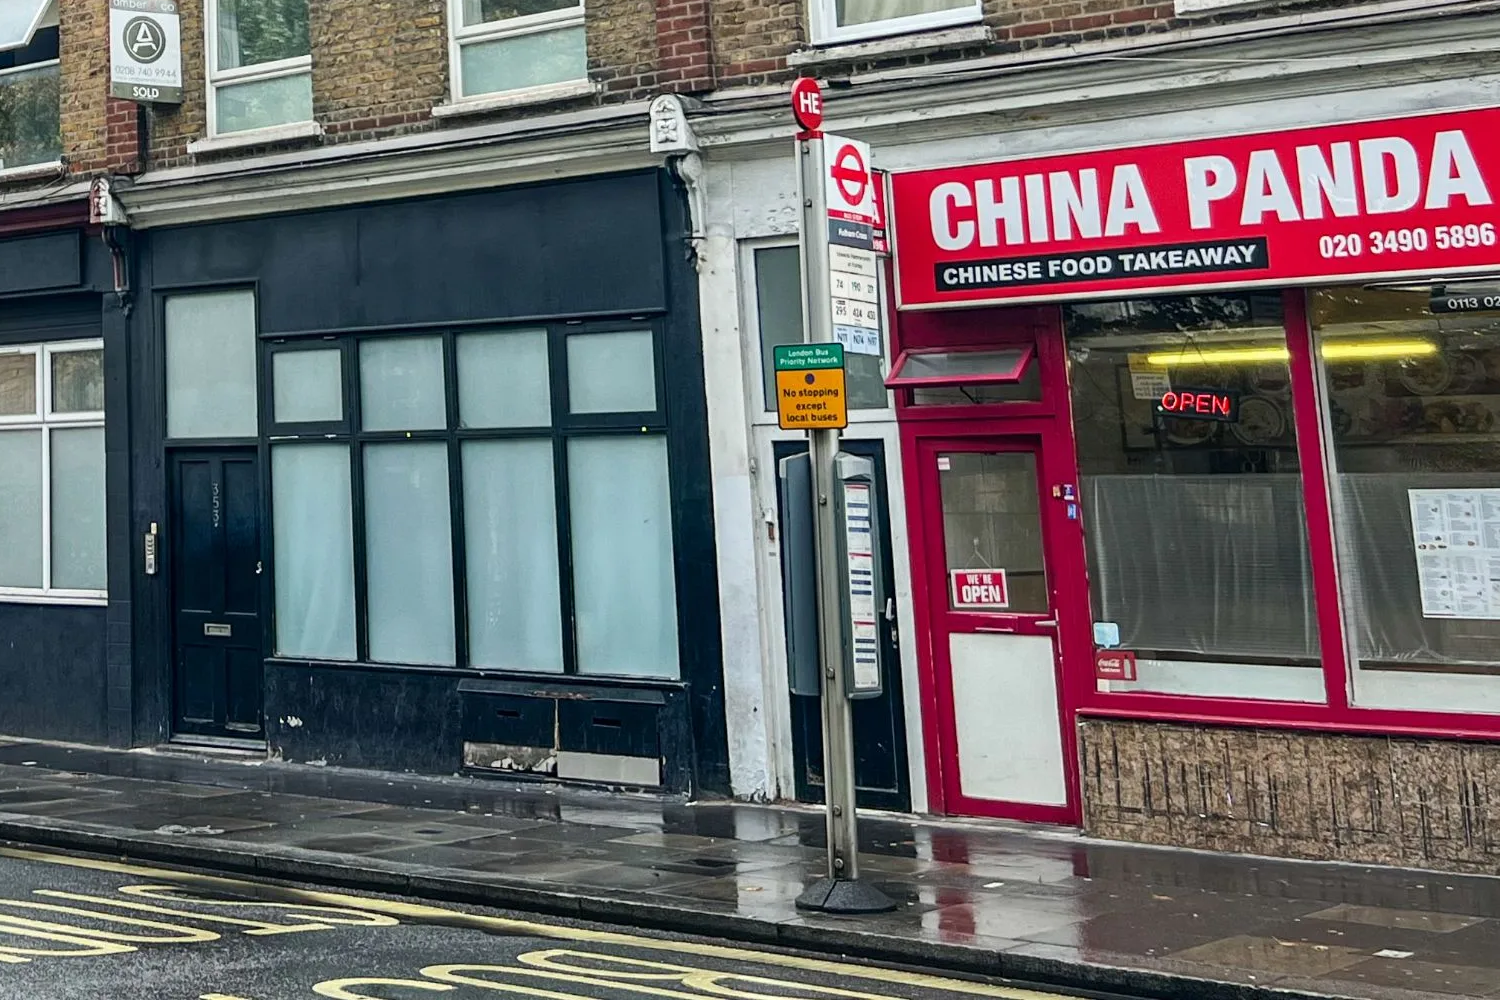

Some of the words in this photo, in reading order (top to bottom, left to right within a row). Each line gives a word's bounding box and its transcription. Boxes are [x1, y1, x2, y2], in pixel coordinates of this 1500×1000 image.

[132, 86, 159, 98] SOLD
[800, 91, 820, 114] HE
[929, 163, 1161, 251] CHINA
[1183, 129, 1493, 230] PANDA
[1319, 233, 1361, 259] 020
[1369, 228, 1428, 255] 3490
[1435, 222, 1495, 250] 5896
[943, 261, 1042, 285] CHINESE
[1048, 256, 1112, 278] FOOD
[1118, 244, 1257, 272] TAKEAWAY
[1447, 297, 1478, 310] 0113
[788, 349, 813, 357] London
[815, 348, 828, 356] Bus
[780, 358, 805, 366] Priority
[807, 356, 838, 364] Network
[783, 388, 796, 398] No
[799, 388, 839, 398] stopping
[796, 402, 827, 411] except
[1162, 391, 1230, 416] OPEN
[786, 413, 808, 422] local
[811, 413, 838, 421] buses
[966, 573, 993, 585] WE'RE
[961, 584, 1001, 603] OPEN
